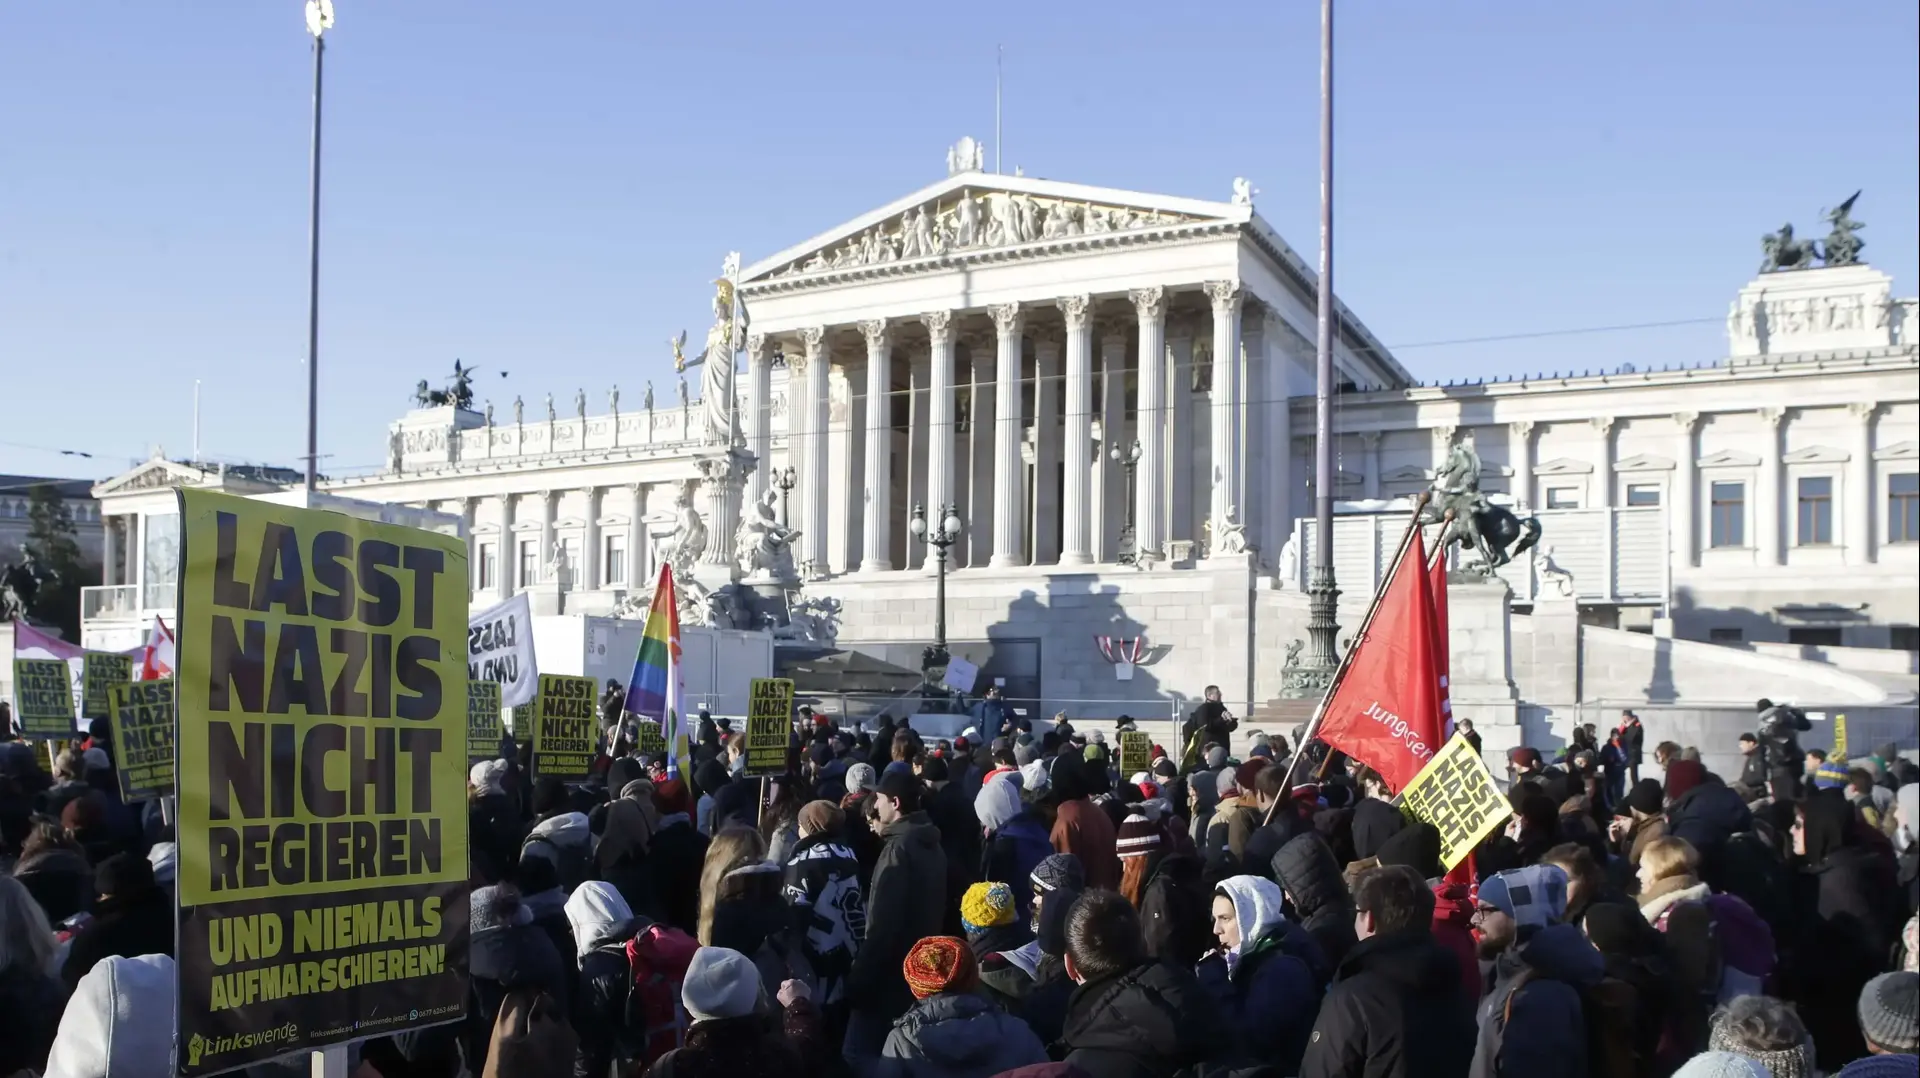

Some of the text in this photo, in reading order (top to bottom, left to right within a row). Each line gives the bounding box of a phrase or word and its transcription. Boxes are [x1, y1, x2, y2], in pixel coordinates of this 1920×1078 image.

[213, 511, 444, 630] LASST
[18, 661, 63, 676] LASST
[88, 654, 128, 667] LASST
[208, 615, 442, 721] NAZIS
[20, 676, 66, 691] NAZIS
[544, 678, 593, 699] LASST
[754, 681, 791, 699] LASST
[22, 691, 67, 706] NICHT
[116, 682, 174, 707] LASS
[469, 698, 498, 712] AZIS
[120, 703, 174, 728] NAZI
[543, 698, 592, 718] NAZIS
[753, 699, 788, 717] NAZIS
[469, 713, 498, 728] ICHT
[541, 717, 591, 738] NICHT
[751, 717, 787, 735] NICHT
[123, 727, 174, 751] NICH
[541, 738, 590, 752] REGIEREN
[750, 734, 786, 747] REGIEREN
[208, 721, 442, 820] NICHT
[1450, 743, 1503, 816] LASST
[1434, 758, 1485, 834] NAZIS
[1418, 774, 1469, 848] NICHT
[208, 818, 442, 892] REGIEREN
[208, 896, 442, 966] UND NIEMALS
[209, 943, 446, 1012] AUFMARSCHIEREN!
[205, 1022, 298, 1056] Linkswende
